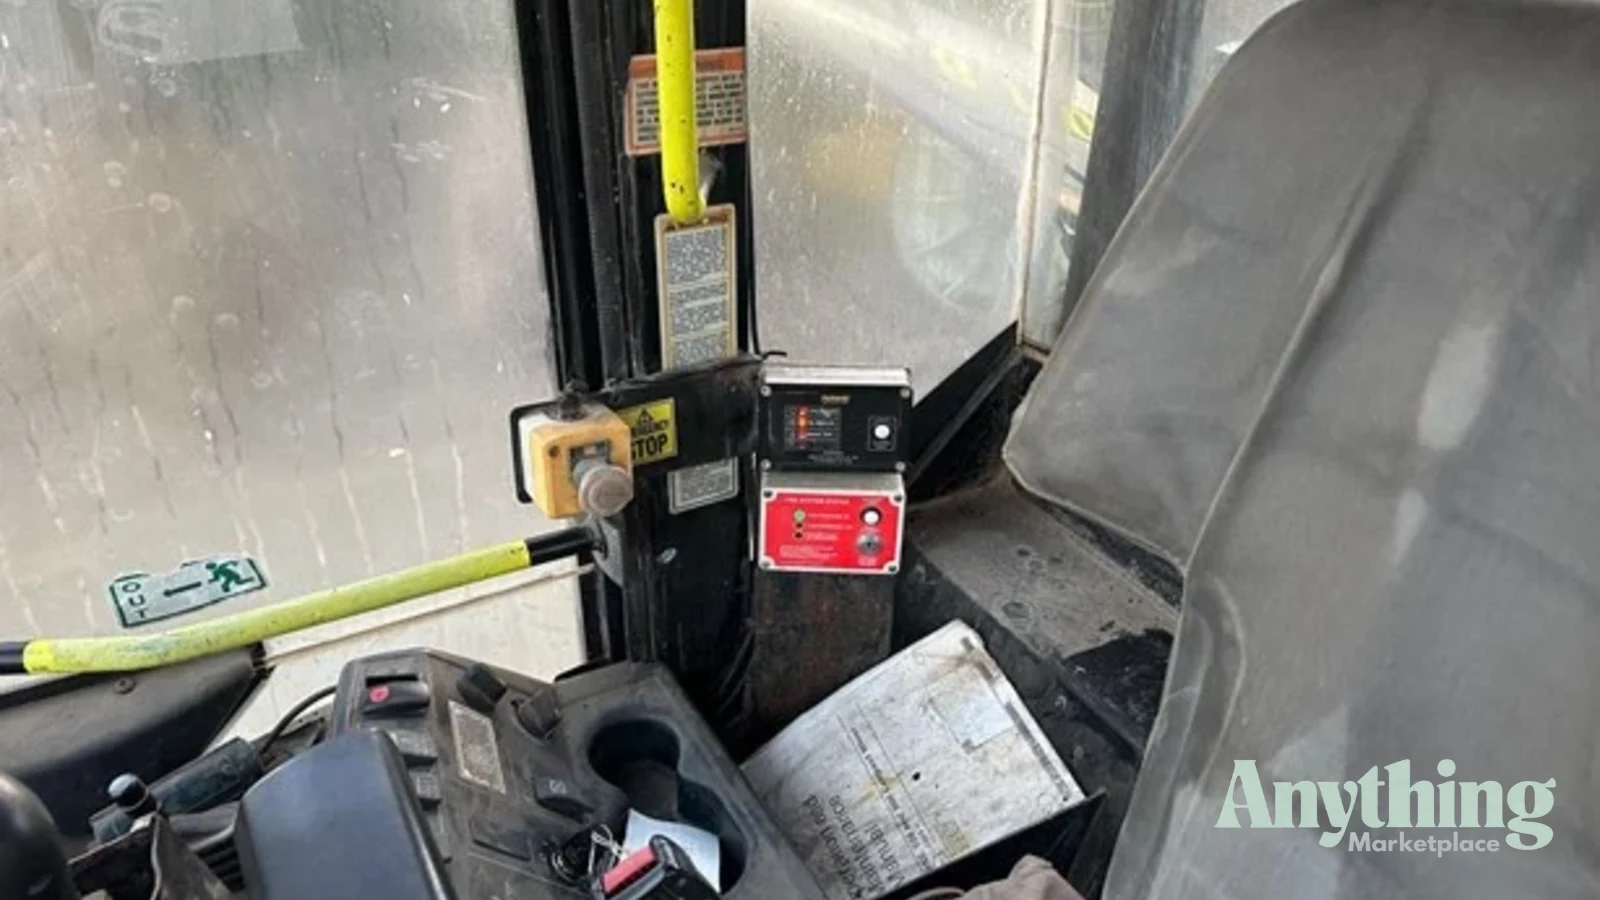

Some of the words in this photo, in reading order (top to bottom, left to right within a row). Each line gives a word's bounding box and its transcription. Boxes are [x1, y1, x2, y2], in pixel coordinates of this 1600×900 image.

[121, 581, 148, 618] OUT
[826, 794, 885, 897] Maintenance
[864, 823, 905, 887] Manual
